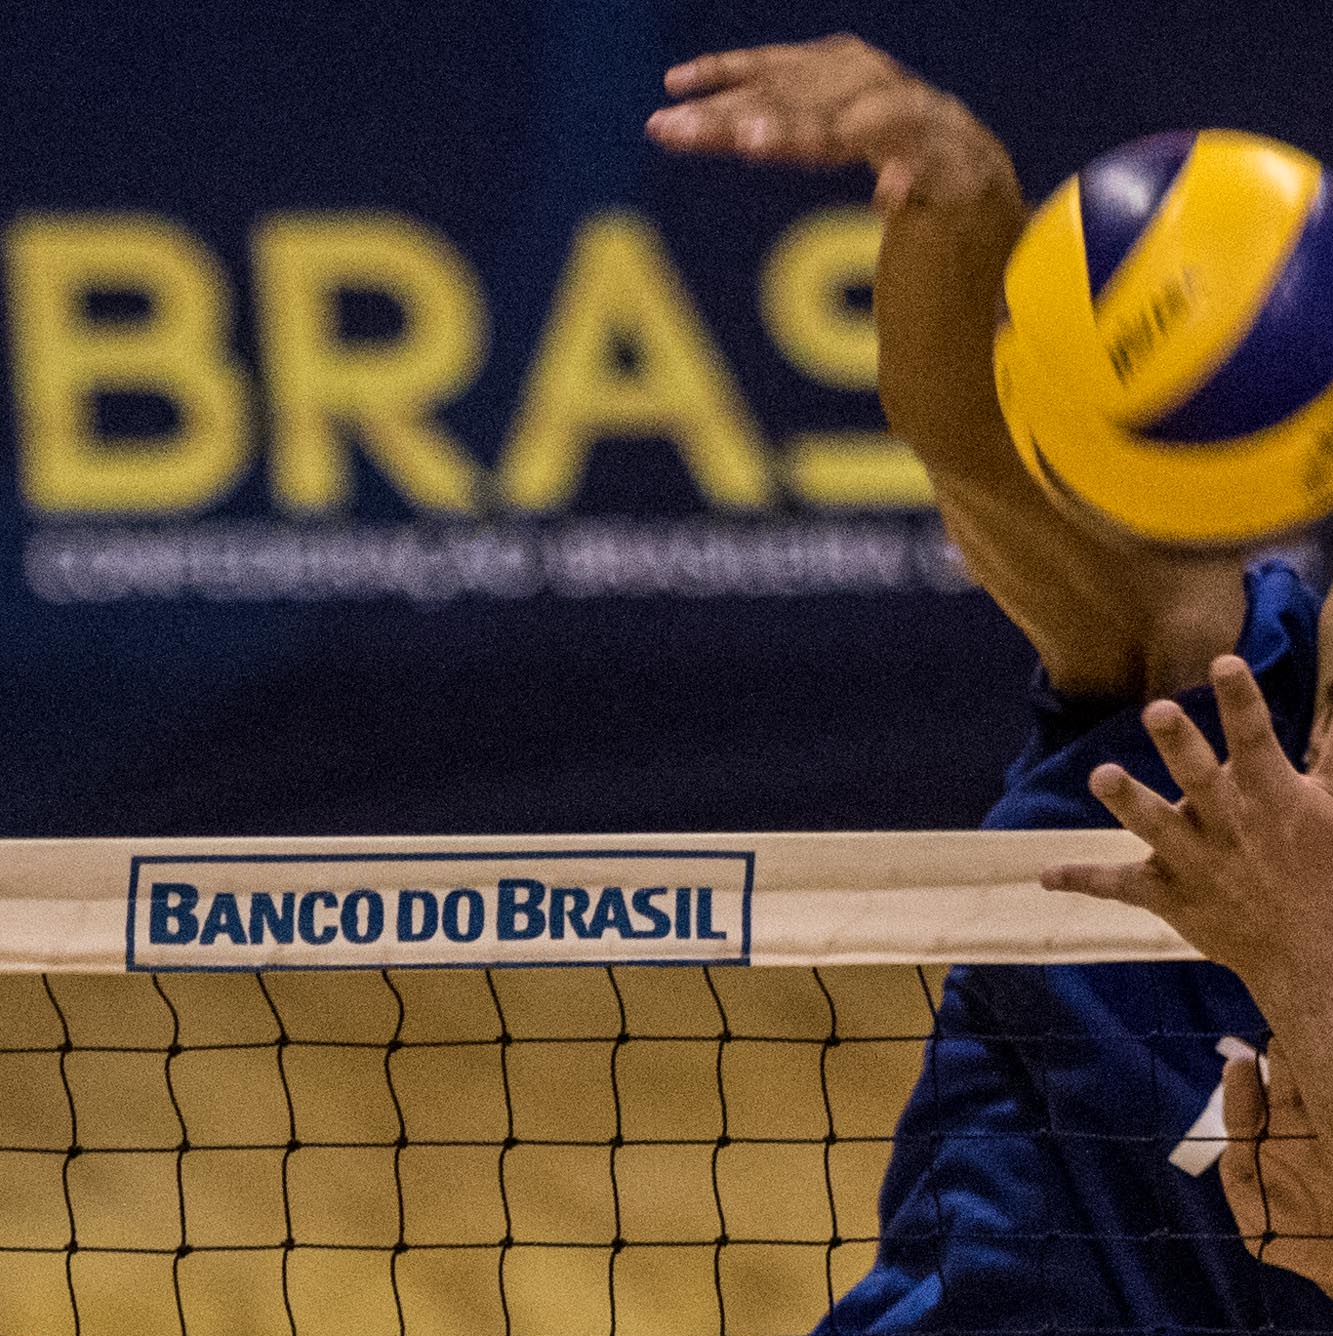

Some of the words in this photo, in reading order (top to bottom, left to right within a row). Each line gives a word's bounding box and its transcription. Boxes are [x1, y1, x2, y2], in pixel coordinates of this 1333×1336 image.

[10, 212, 934, 512] BRAS
[149, 882, 384, 946] BANCO
[400, 888, 484, 943] DO
[496, 877, 727, 941] BRASIL
